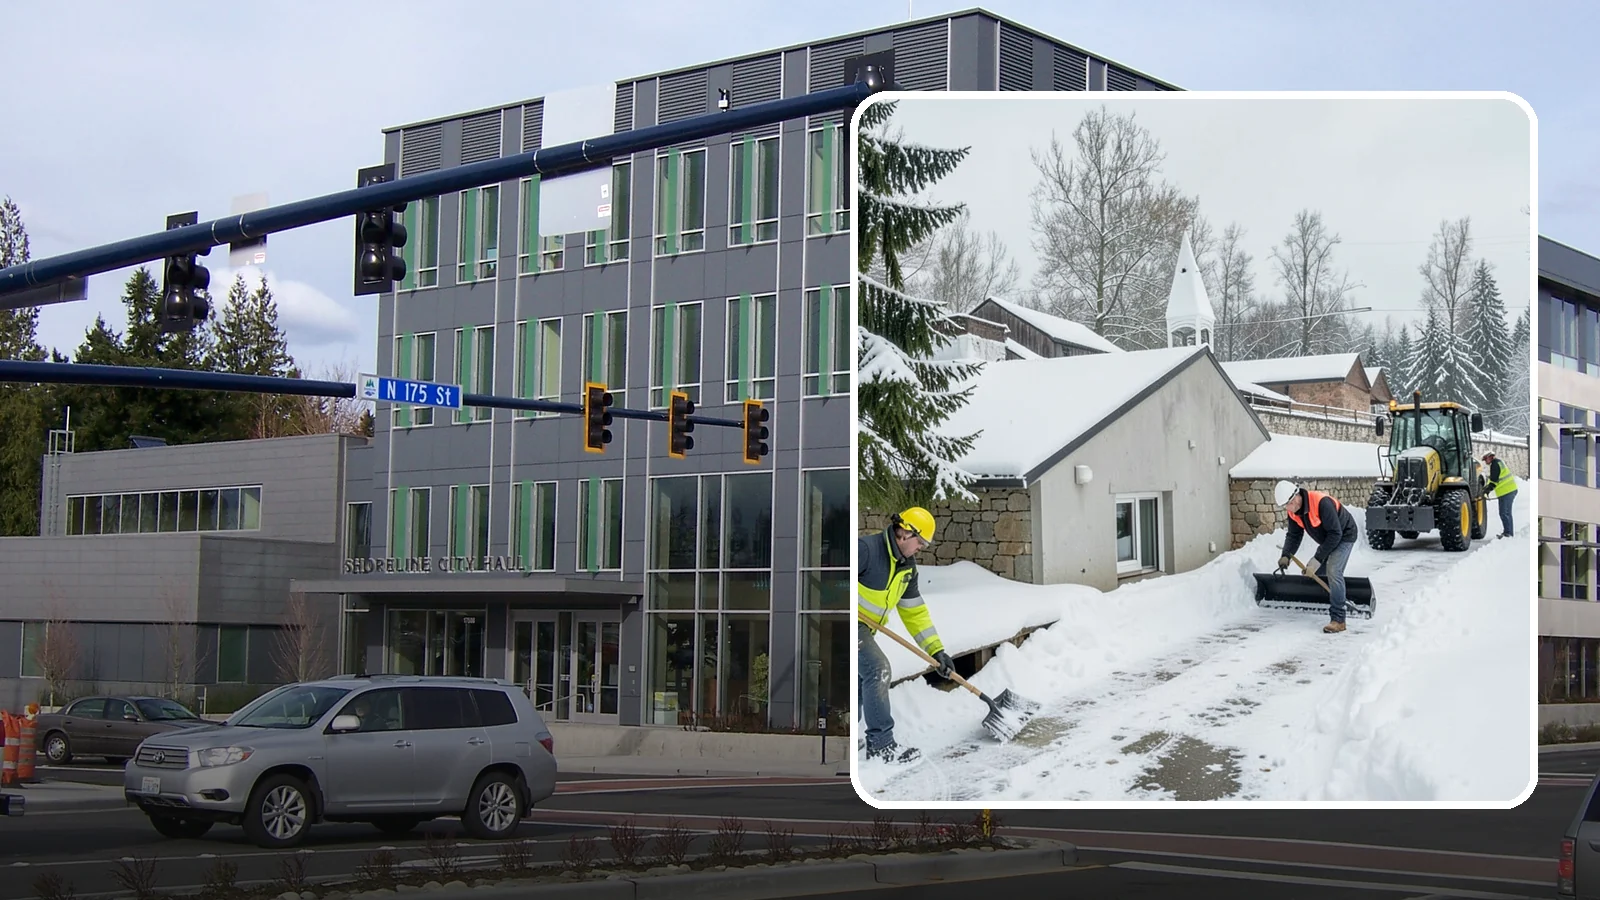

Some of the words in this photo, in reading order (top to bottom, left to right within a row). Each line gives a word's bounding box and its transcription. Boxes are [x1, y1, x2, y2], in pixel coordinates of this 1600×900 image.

[387, 380, 396, 400] N
[405, 382, 427, 403] 175
[436, 386, 451, 406] St
[344, 556, 432, 574] SHORELINE
[438, 555, 475, 572] CITY
[484, 555, 526, 572] HALL
